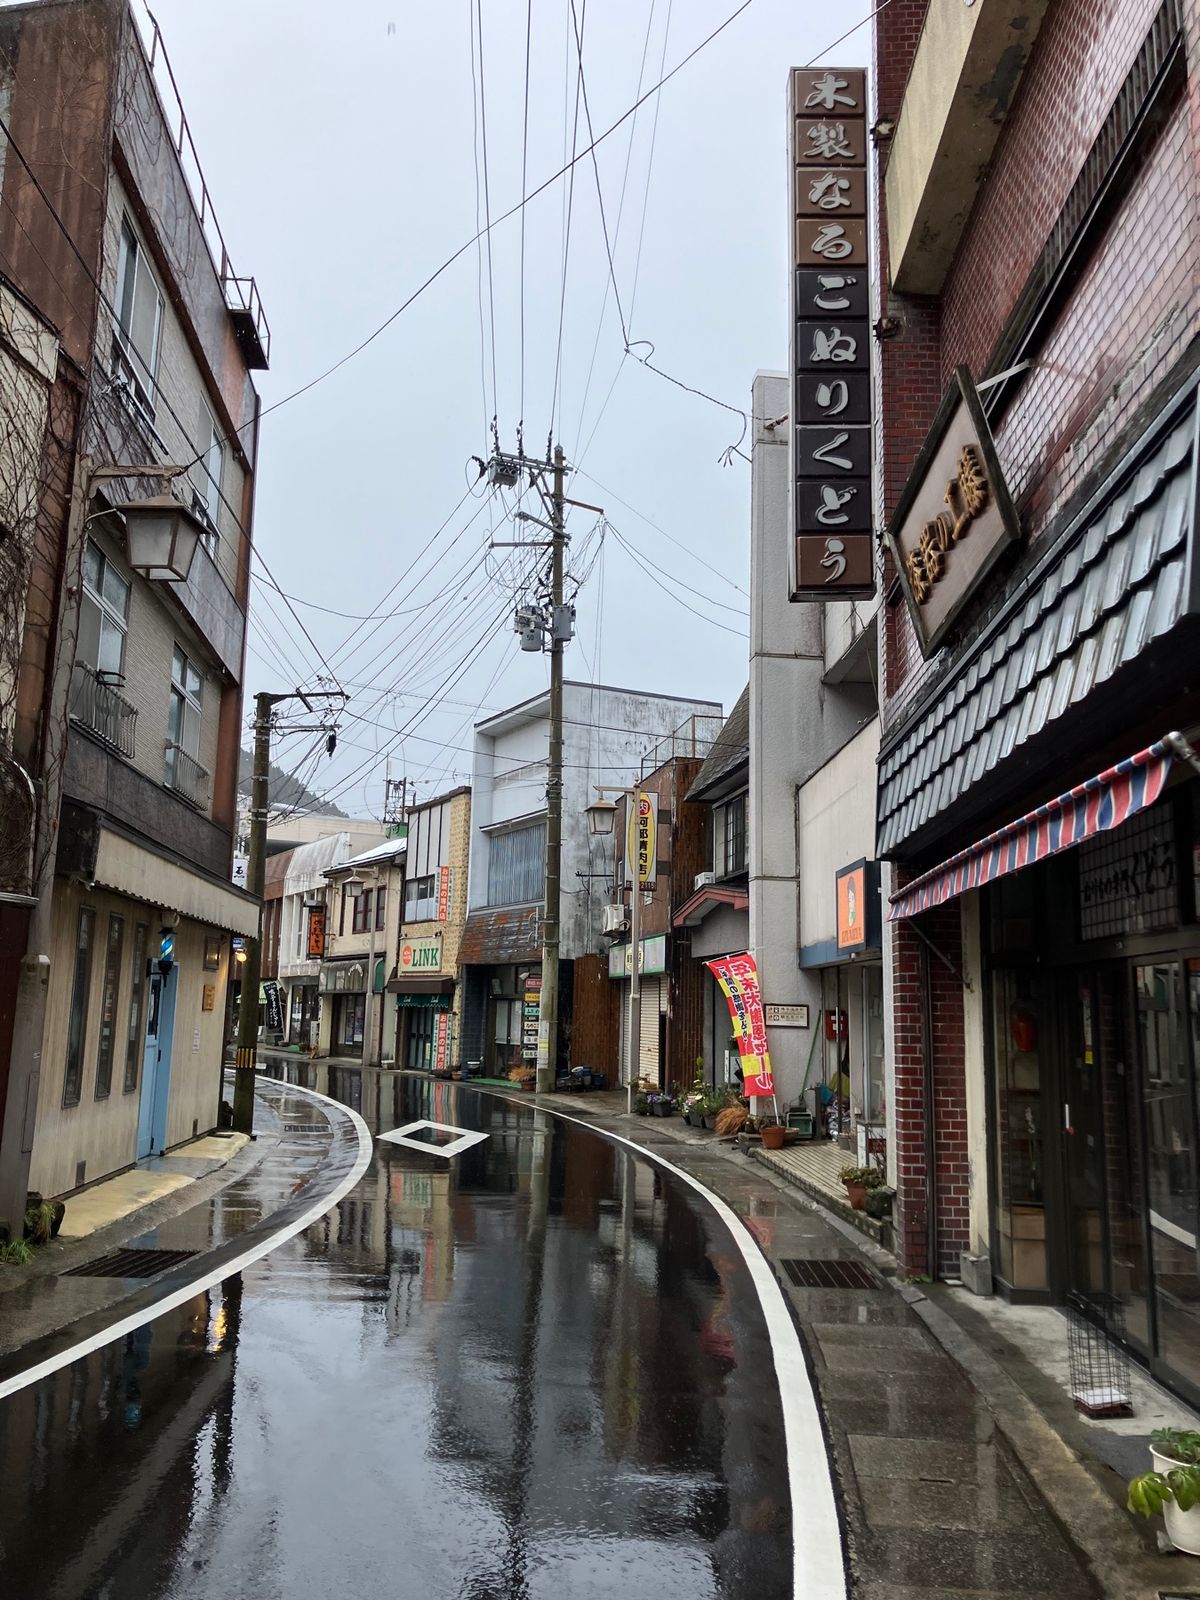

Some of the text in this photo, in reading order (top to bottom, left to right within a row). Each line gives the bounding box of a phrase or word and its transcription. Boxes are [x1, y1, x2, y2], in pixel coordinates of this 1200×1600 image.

[804, 73, 858, 584] 木製なるごぬりくどう
[412, 948, 439, 967] LINK
